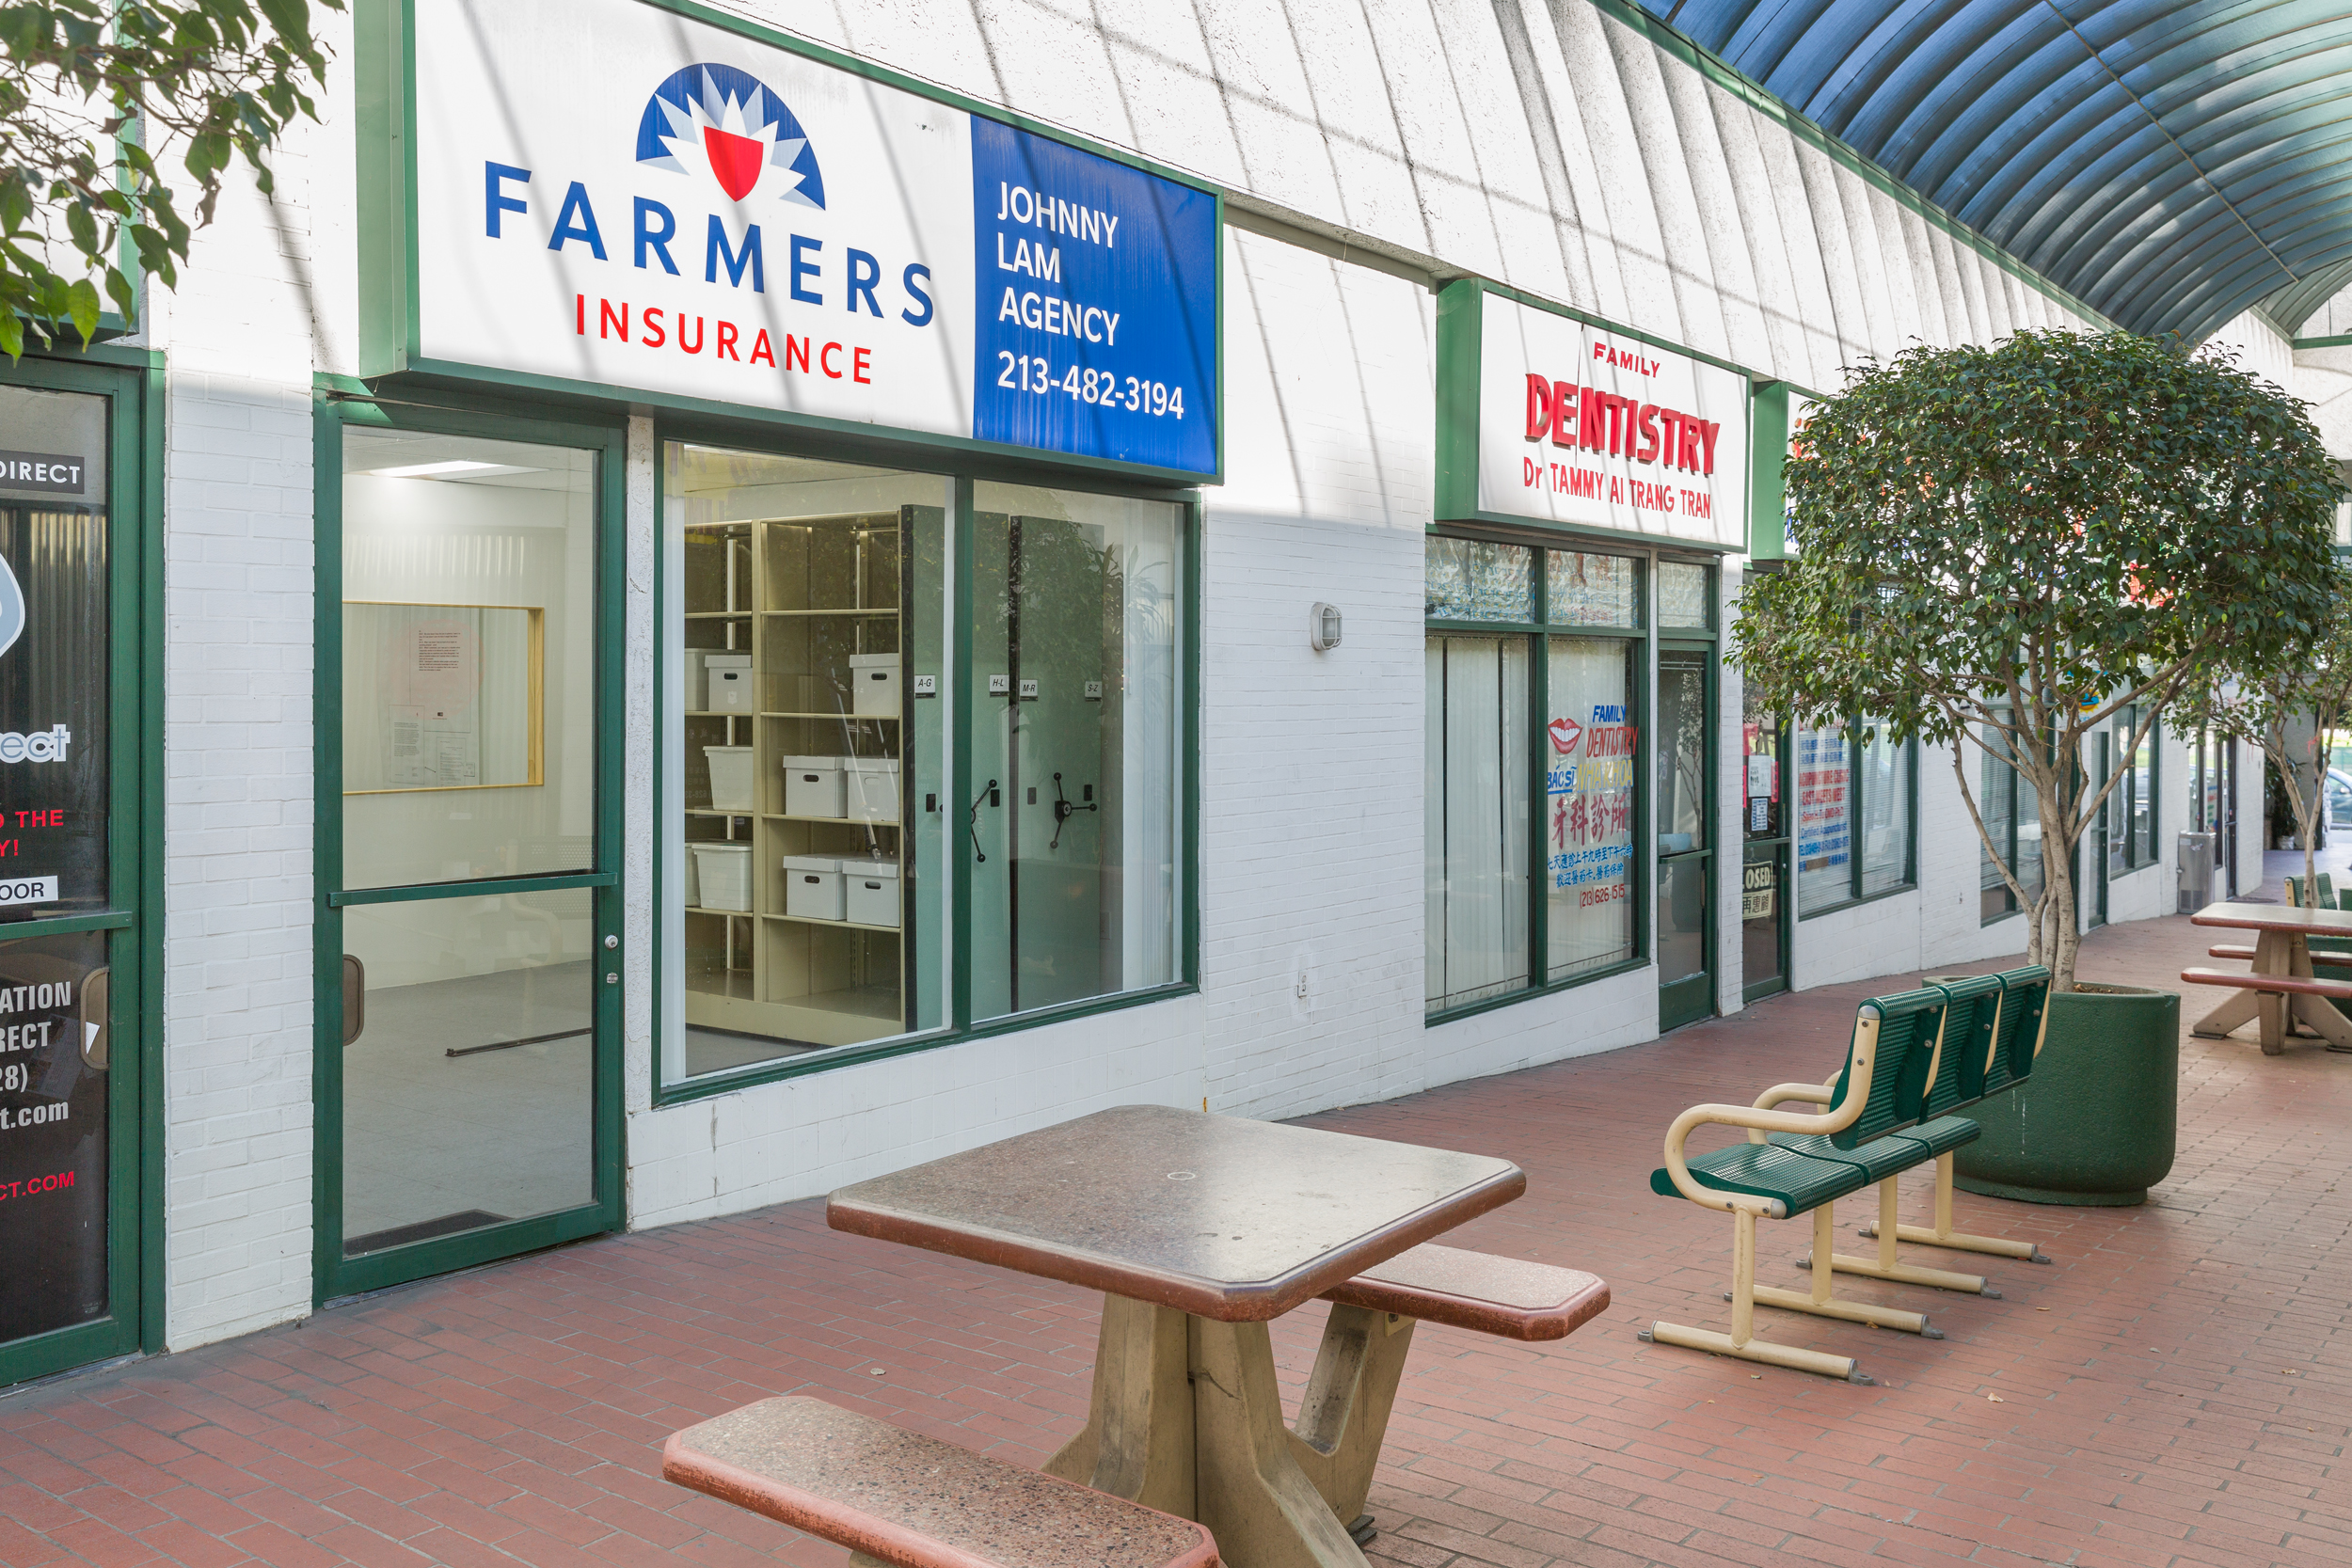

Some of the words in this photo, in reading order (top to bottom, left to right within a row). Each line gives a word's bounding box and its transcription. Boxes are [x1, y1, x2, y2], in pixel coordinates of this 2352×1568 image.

[997, 181, 1119, 248] JOHNNY
[485, 161, 934, 327] FARMERS
[997, 231, 1061, 284] LAM
[998, 286, 1120, 346] AGENCY
[576, 293, 873, 385] INSURANCE
[1593, 341, 1661, 378] FAMILY
[997, 350, 1184, 420] 213-482-3194
[1524, 372, 1721, 478] DENTISTRY
[1523, 456, 1543, 489] Dr
[1549, 462, 1604, 501] TAMMY
[1609, 475, 1625, 505] AI
[1629, 478, 1675, 513] TRANG
[1679, 489, 1710, 519] TRAN
[918, 678, 931, 688] A-G
[993, 678, 1005, 687] H-L
[1023, 684, 1036, 692] M-R
[1088, 684, 1099, 692] S-Z
[1592, 705, 1627, 723] FAMILY
[1586, 726, 1639, 758] DENTISTRY
[15, 810, 64, 828] THE
[1551, 793, 1629, 850] 牙科診所
[0, 981, 72, 1014] ATION
